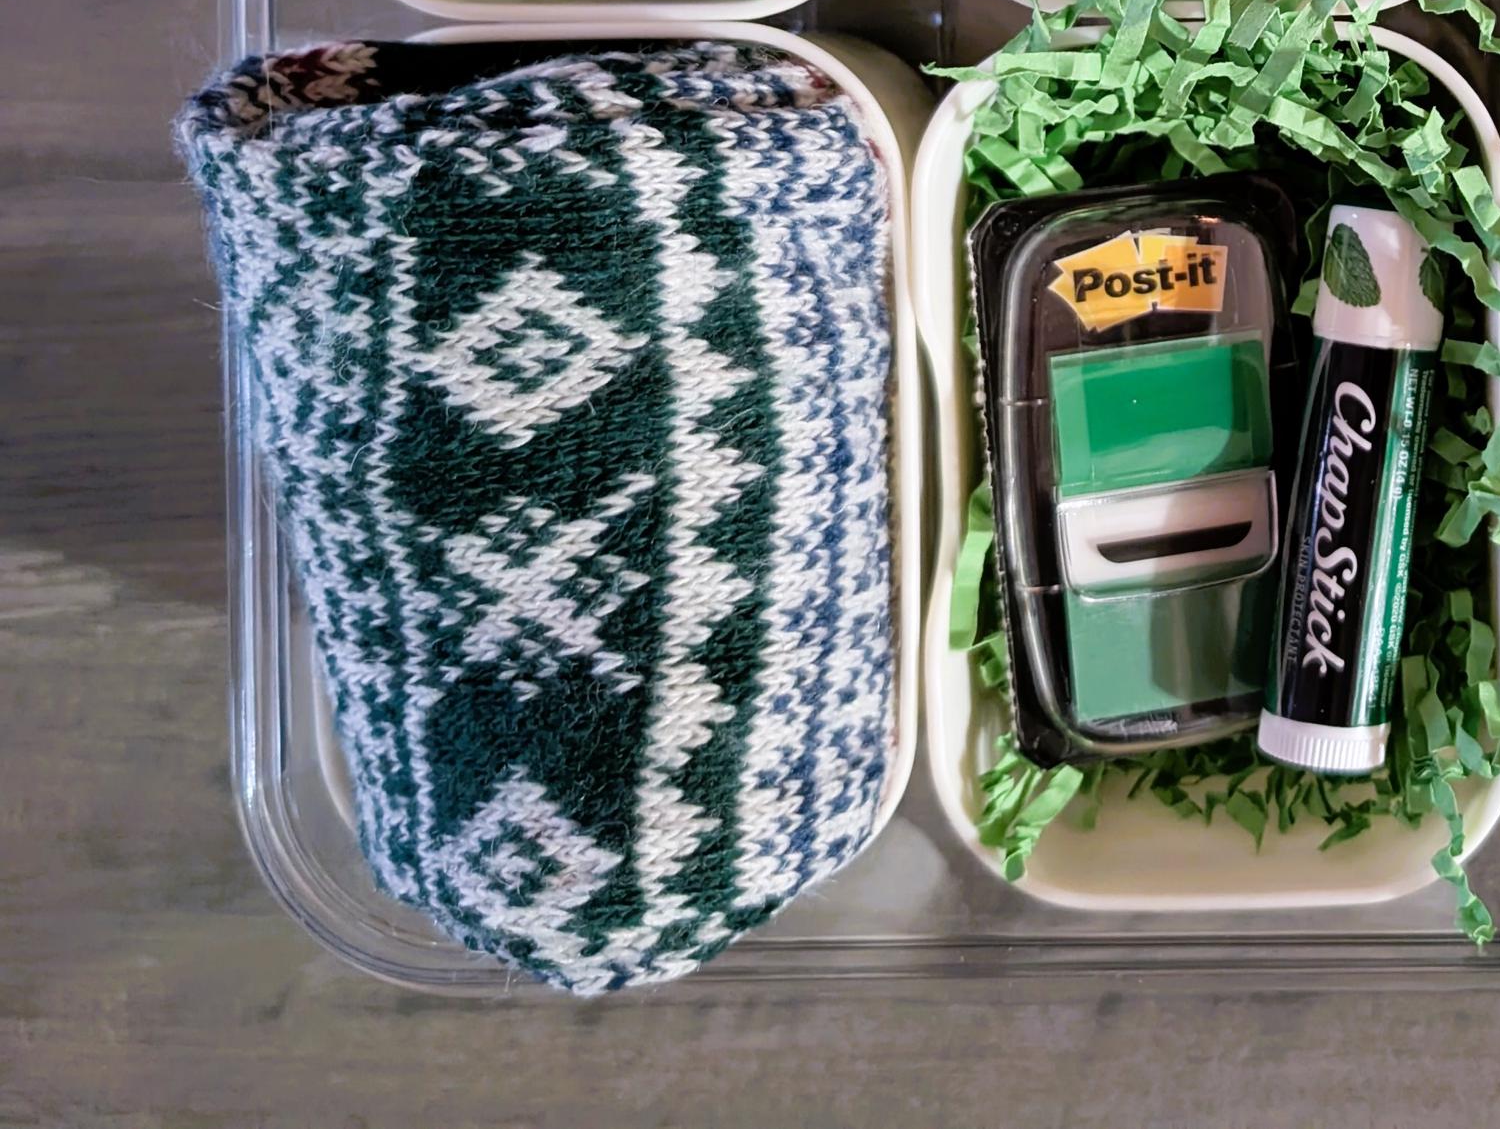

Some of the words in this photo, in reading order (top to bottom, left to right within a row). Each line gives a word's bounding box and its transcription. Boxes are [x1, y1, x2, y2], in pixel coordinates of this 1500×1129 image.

[1073, 252, 1217, 302] Post-it
[1406, 367, 1419, 392] NET
[1398, 450, 1410, 468] OZ
[1402, 488, 1414, 535] licensed
[1301, 381, 1376, 675] ChapStick
[1297, 535, 1310, 568] SKIN
[1398, 537, 1407, 551] by
[1395, 553, 1406, 578] GSK
[1386, 624, 1396, 649] GSK
